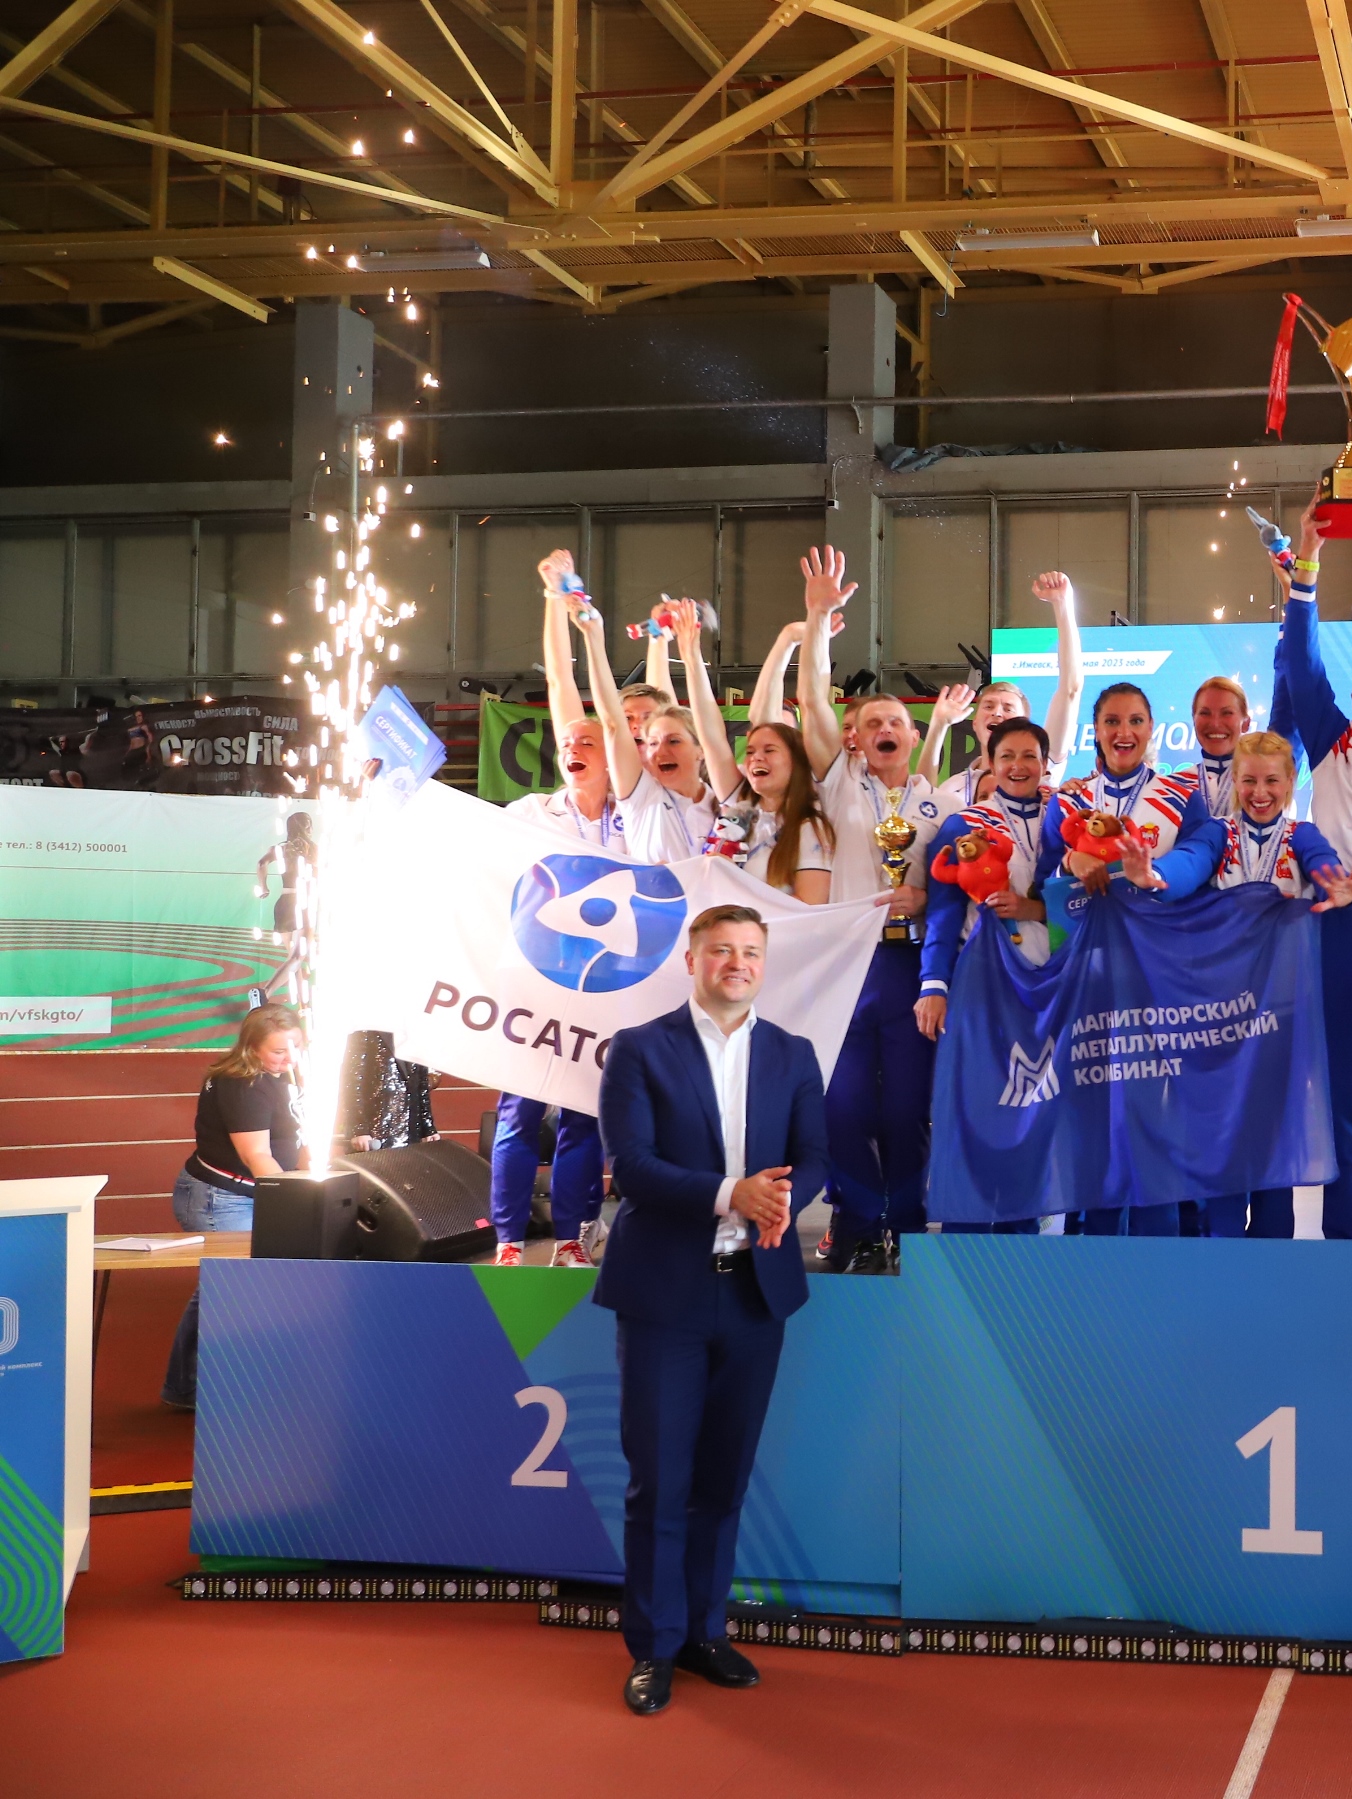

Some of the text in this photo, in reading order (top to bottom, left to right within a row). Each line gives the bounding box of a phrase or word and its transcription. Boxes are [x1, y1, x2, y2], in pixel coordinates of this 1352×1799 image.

[1102, 659, 1123, 667] 2023
[263, 715, 299, 731] СИЛА
[375, 716, 418, 760] СЕРТИФИКАТ
[159, 731, 285, 767] CrossFit
[36, 841, 42, 850] 8
[46, 842, 82, 853] (3412)
[86, 843, 127, 853] 500001
[1071, 990, 1257, 1039] МАГНИТОГОРСКИЙ
[1070, 1010, 1279, 1062] МЕТАЛЛУРГИЧЕСКИЙ
[1074, 1057, 1183, 1086] КОМБИНАТ
[511, 1386, 568, 1488] 2
[1235, 1406, 1323, 1556] 1
